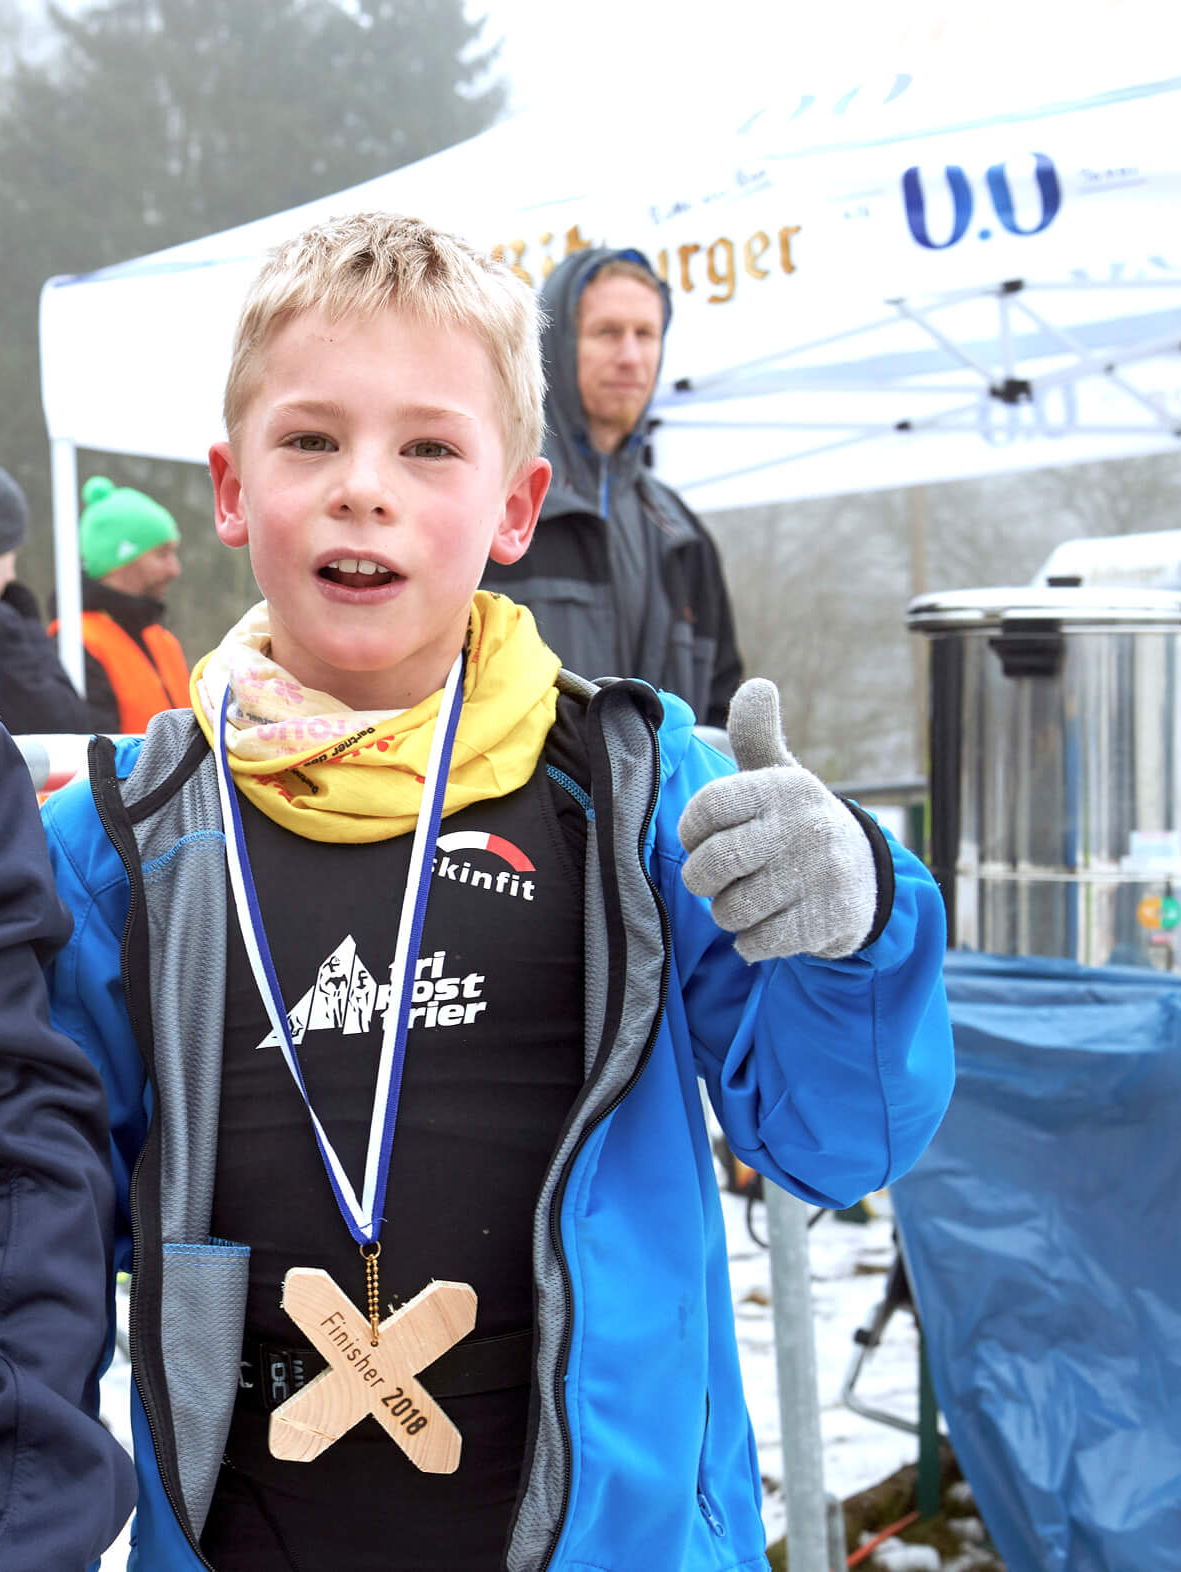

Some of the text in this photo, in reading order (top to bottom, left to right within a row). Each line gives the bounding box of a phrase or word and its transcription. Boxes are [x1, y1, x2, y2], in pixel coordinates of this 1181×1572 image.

[389, 951, 446, 982] ri
[381, 1001, 487, 1032] rier
[320, 1311, 428, 1436] Finisher 2018
